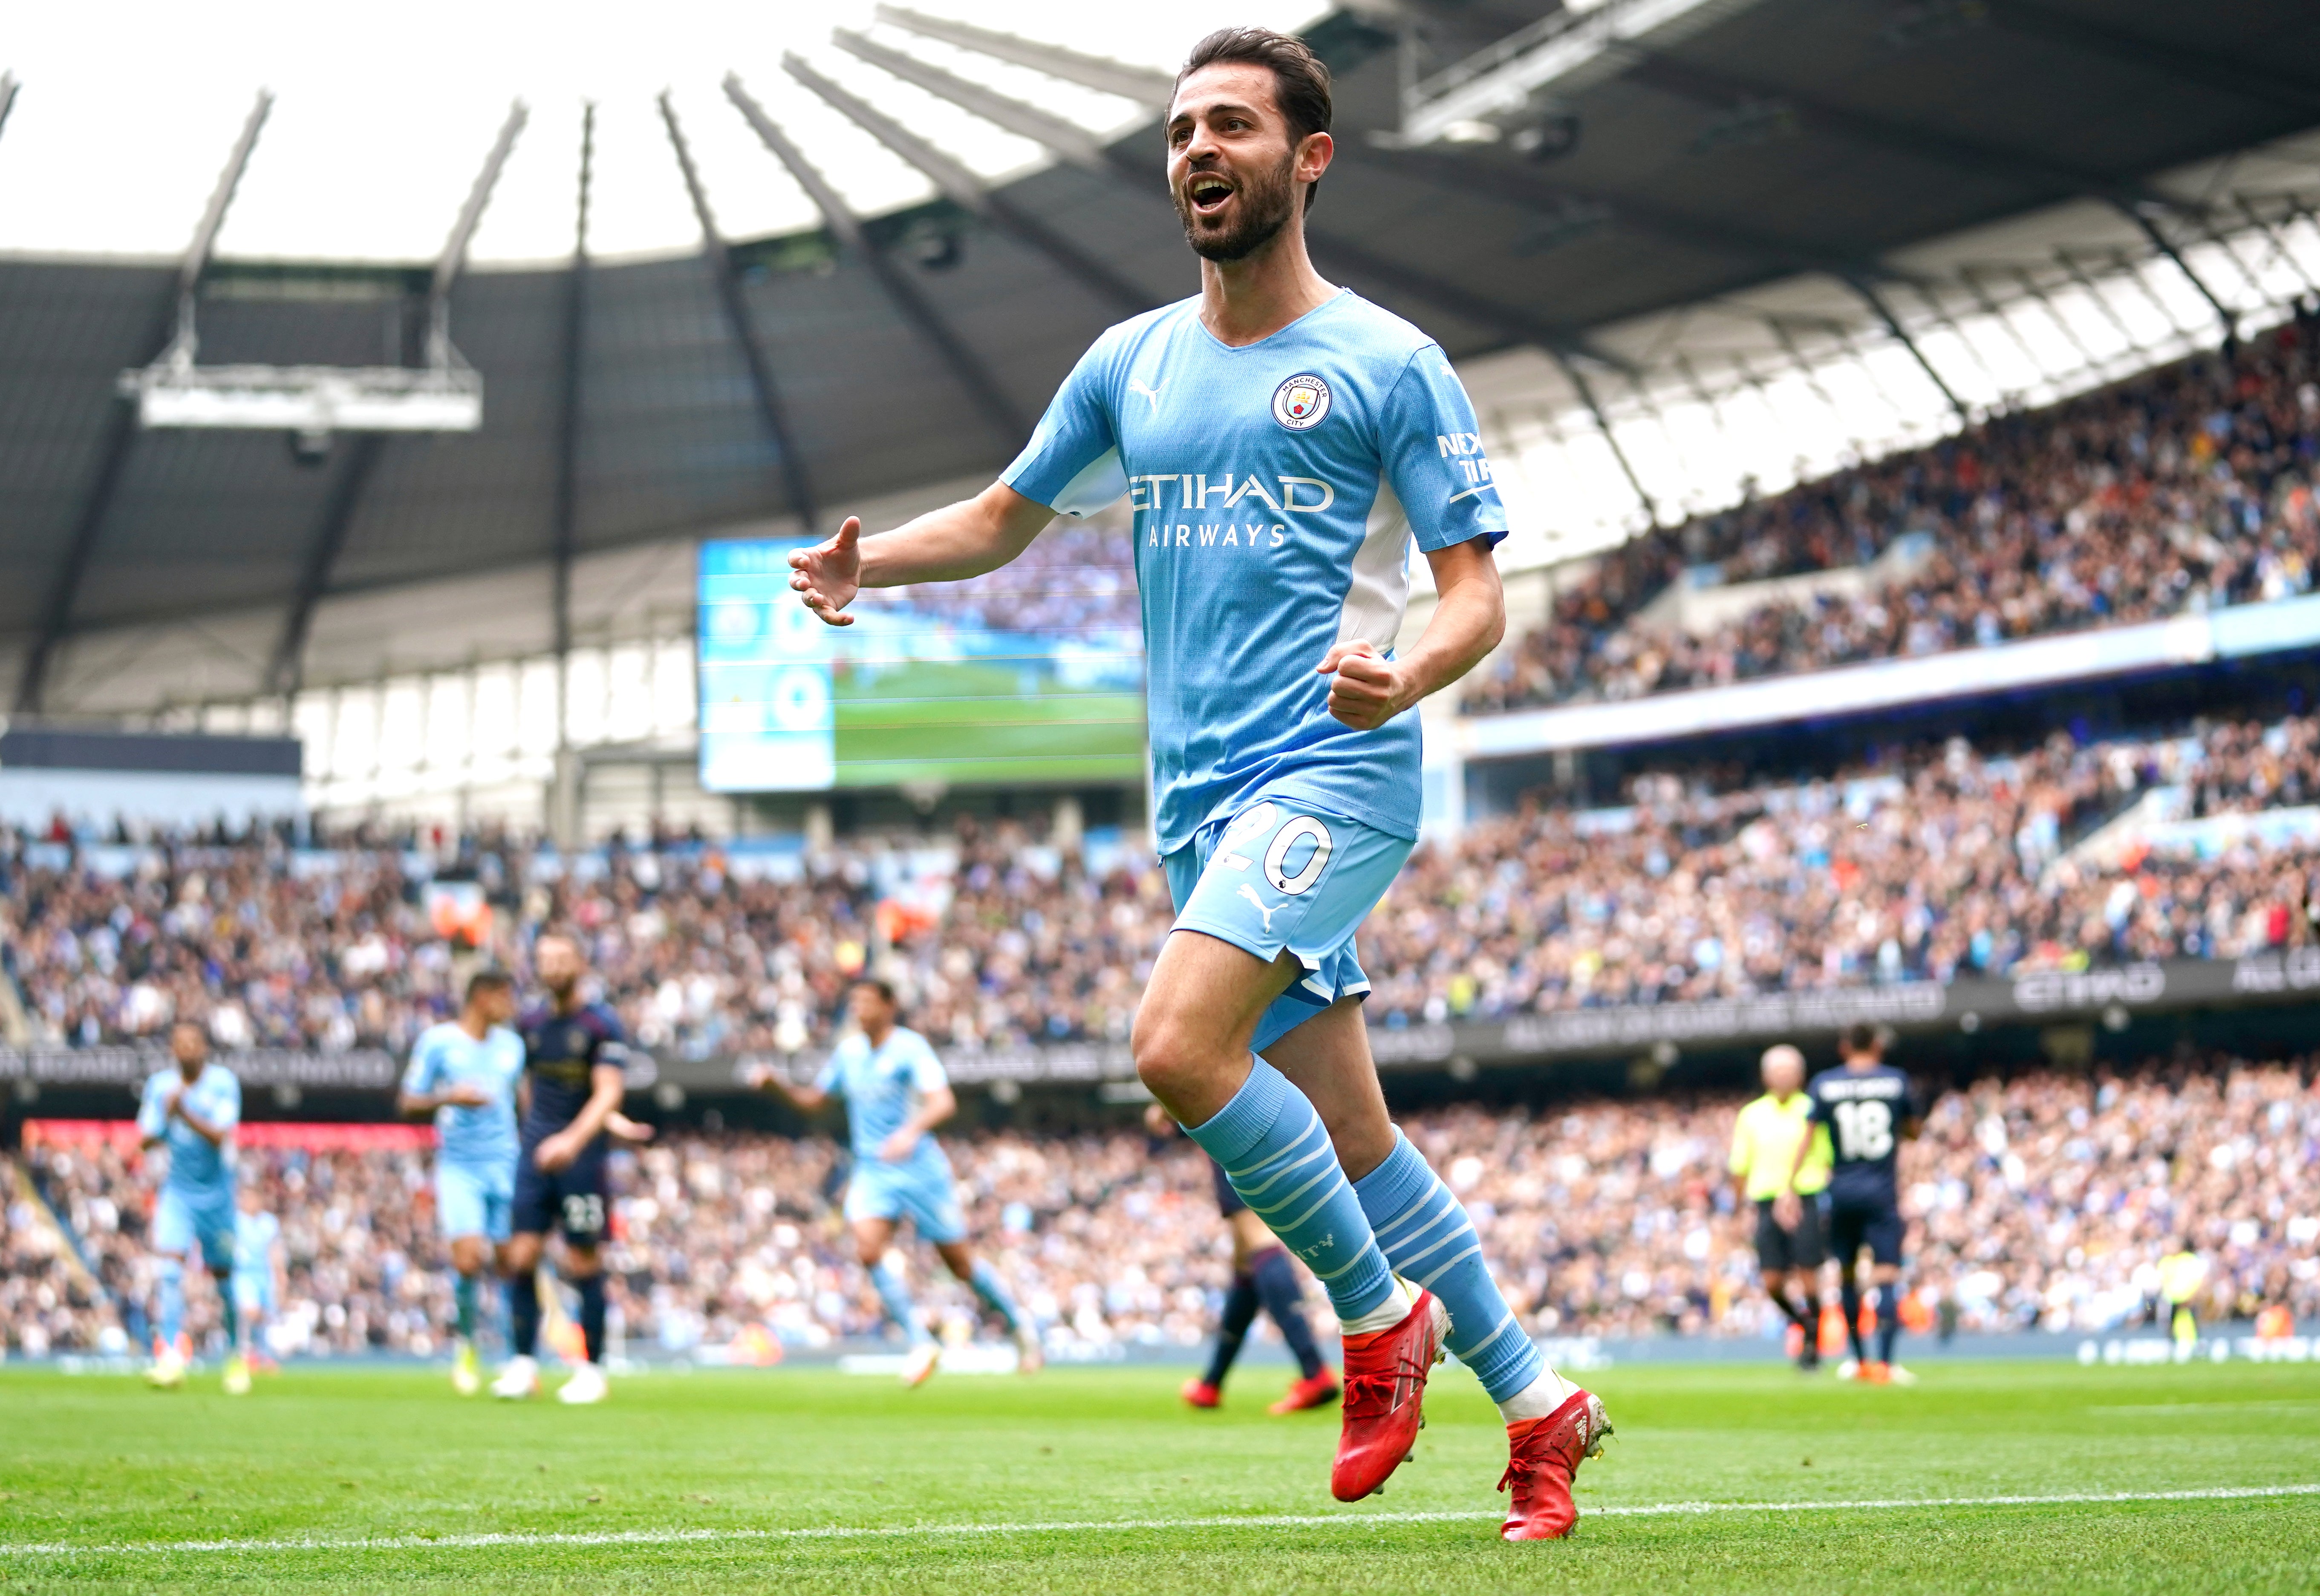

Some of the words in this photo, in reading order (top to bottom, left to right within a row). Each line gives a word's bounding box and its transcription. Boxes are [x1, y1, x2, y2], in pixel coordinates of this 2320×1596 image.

[1283, 378, 1327, 398] MANCHESTER
[1130, 473, 1334, 512] ETIHAD
[1149, 524, 1285, 547] AIRWAYS
[1208, 801, 1333, 895] 20
[1834, 1100, 1893, 1161] 18
